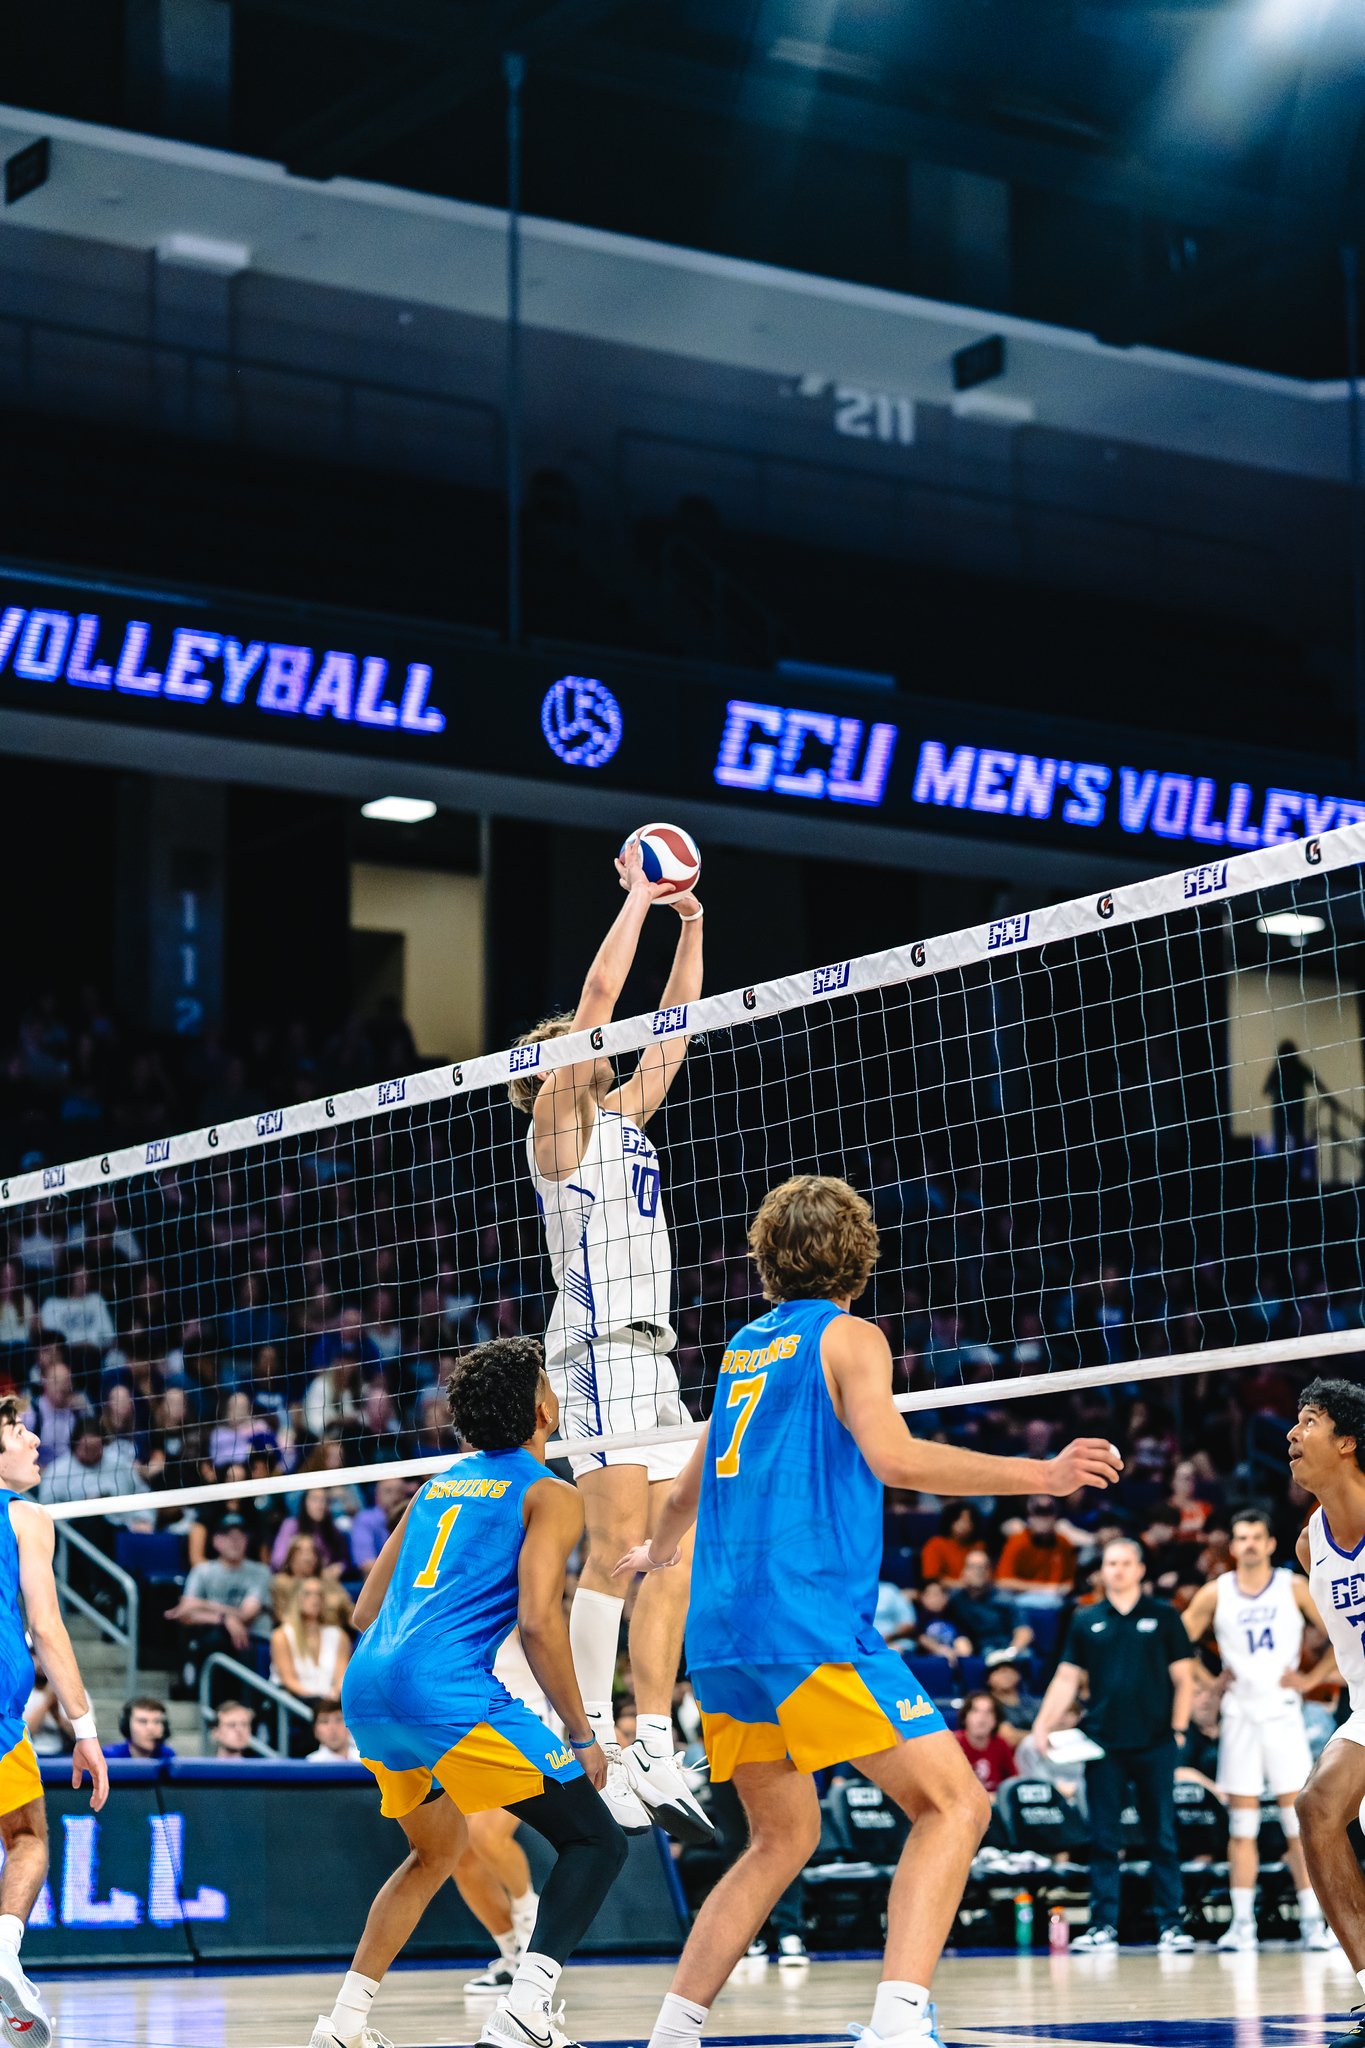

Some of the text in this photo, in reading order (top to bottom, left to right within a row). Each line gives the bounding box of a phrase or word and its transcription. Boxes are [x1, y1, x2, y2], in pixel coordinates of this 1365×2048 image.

[834, 384, 916, 447] 211
[714, 699, 1365, 851] GCU MEN'S VOLLEY
[100, 1156, 110, 1174] G
[145, 1140, 170, 1165] GCU
[208, 1128, 219, 1147] G
[256, 1110, 283, 1136] GCU
[325, 1098, 335, 1118] G
[378, 1078, 406, 1106] GCU
[452, 1064, 464, 1086] G
[509, 1043, 541, 1073] GCU
[590, 1026, 604, 1050] G
[653, 1004, 689, 1035] GCU
[742, 987, 756, 1010] G
[813, 961, 850, 996] GCU
[910, 942, 926, 967] G
[987, 914, 1031, 950] GCU
[1096, 893, 1114, 919] G
[1183, 861, 1229, 899] GCU
[1305, 836, 1322, 866] G
[632, 1163, 661, 1218] 10
[716, 1372, 768, 1478] 7
[424, 1479, 512, 1500] BRUINS
[412, 1504, 463, 1588] 1
[1246, 1626, 1274, 1655] 14
